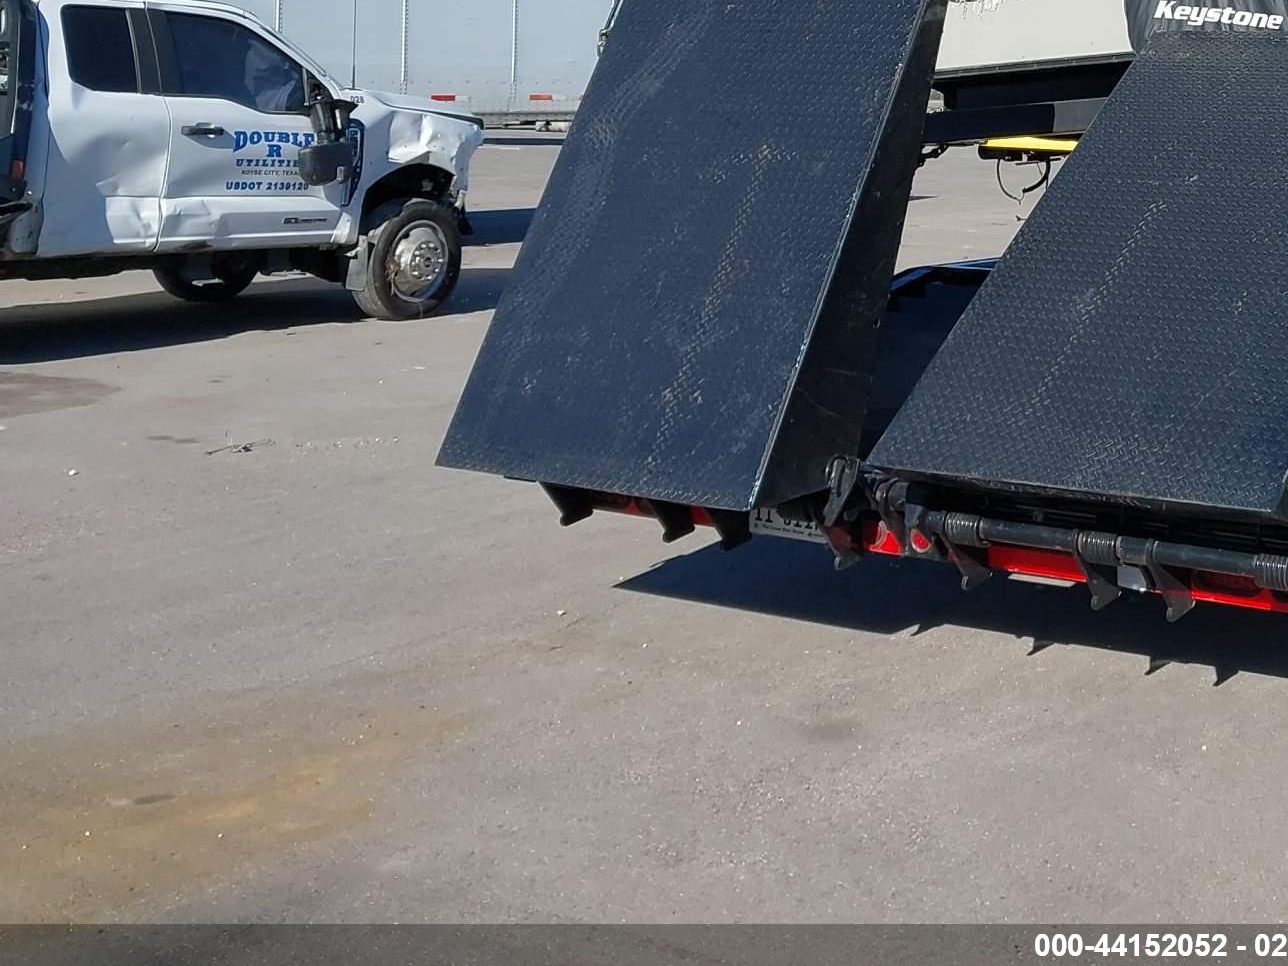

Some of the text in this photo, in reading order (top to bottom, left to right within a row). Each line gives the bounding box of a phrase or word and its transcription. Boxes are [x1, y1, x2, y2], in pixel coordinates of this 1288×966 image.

[1154, 0, 1284, 30] Keystone
[233, 130, 315, 152] DOUBLE
[266, 144, 282, 158] R
[235, 158, 299, 167] UTILITIE
[263, 169, 280, 177] CITY,
[225, 181, 263, 191] USDOT
